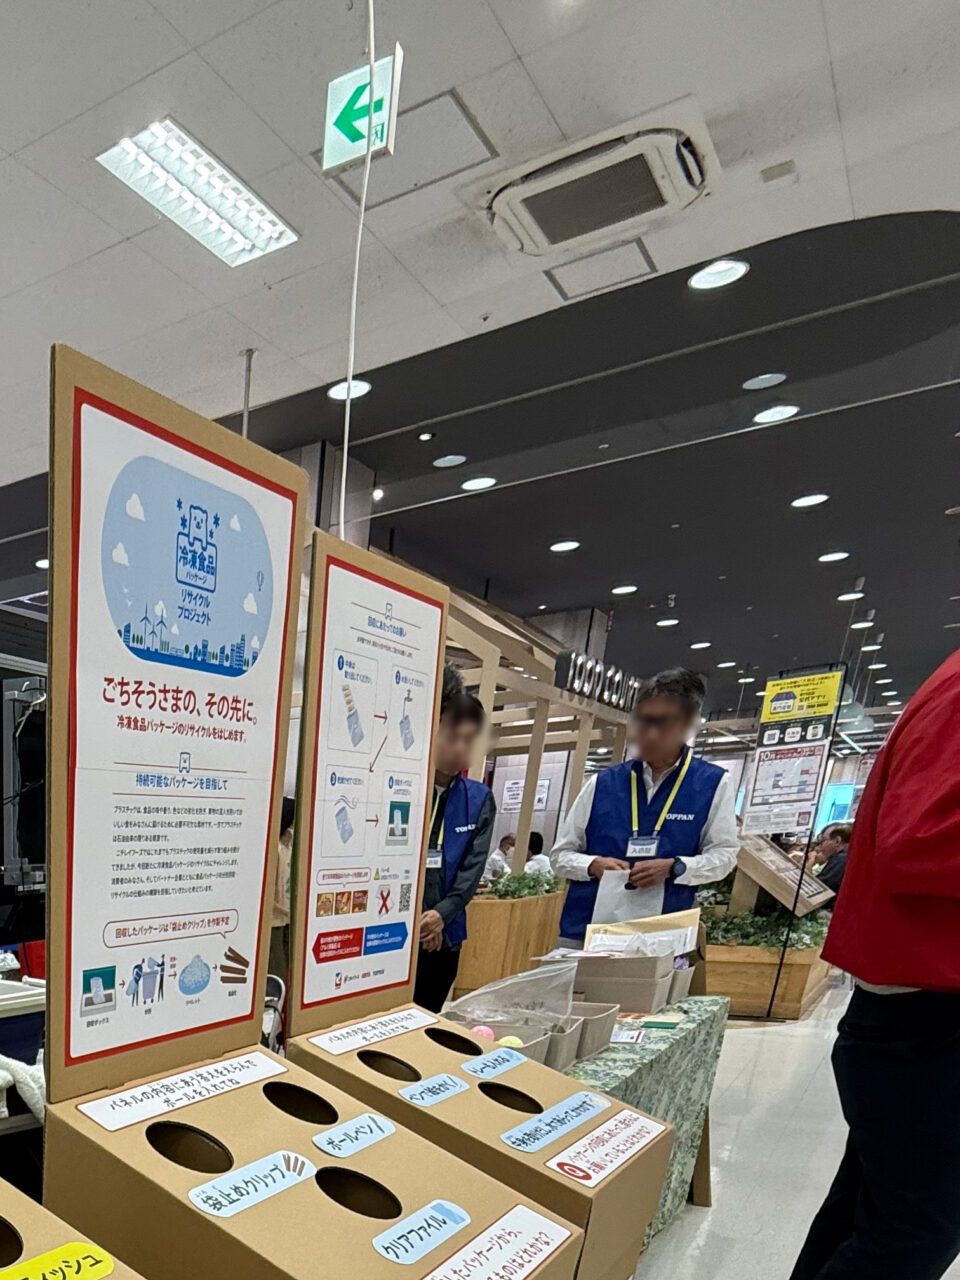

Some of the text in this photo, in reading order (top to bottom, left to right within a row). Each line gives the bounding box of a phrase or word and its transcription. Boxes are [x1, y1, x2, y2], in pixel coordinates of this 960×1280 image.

[179, 545, 214, 576] 冷凍食品
[186, 572, 207, 585] パッケージ
[181, 588, 211, 608] リサイクル
[178, 605, 211, 626] プロジェクト
[103, 676, 257, 725] ごちそうさまの、その先に。
[666, 813, 695, 821] OPPAN
[109, 1058, 258, 1111] パネルの内容にあう答えをえらんで
[162, 1077, 241, 1108] ボールを入れてね
[325, 1123, 374, 1151] ボールペン
[199, 1162, 286, 1212] 袋止めクリップ
[381, 1214, 448, 1260] クリアファイル
